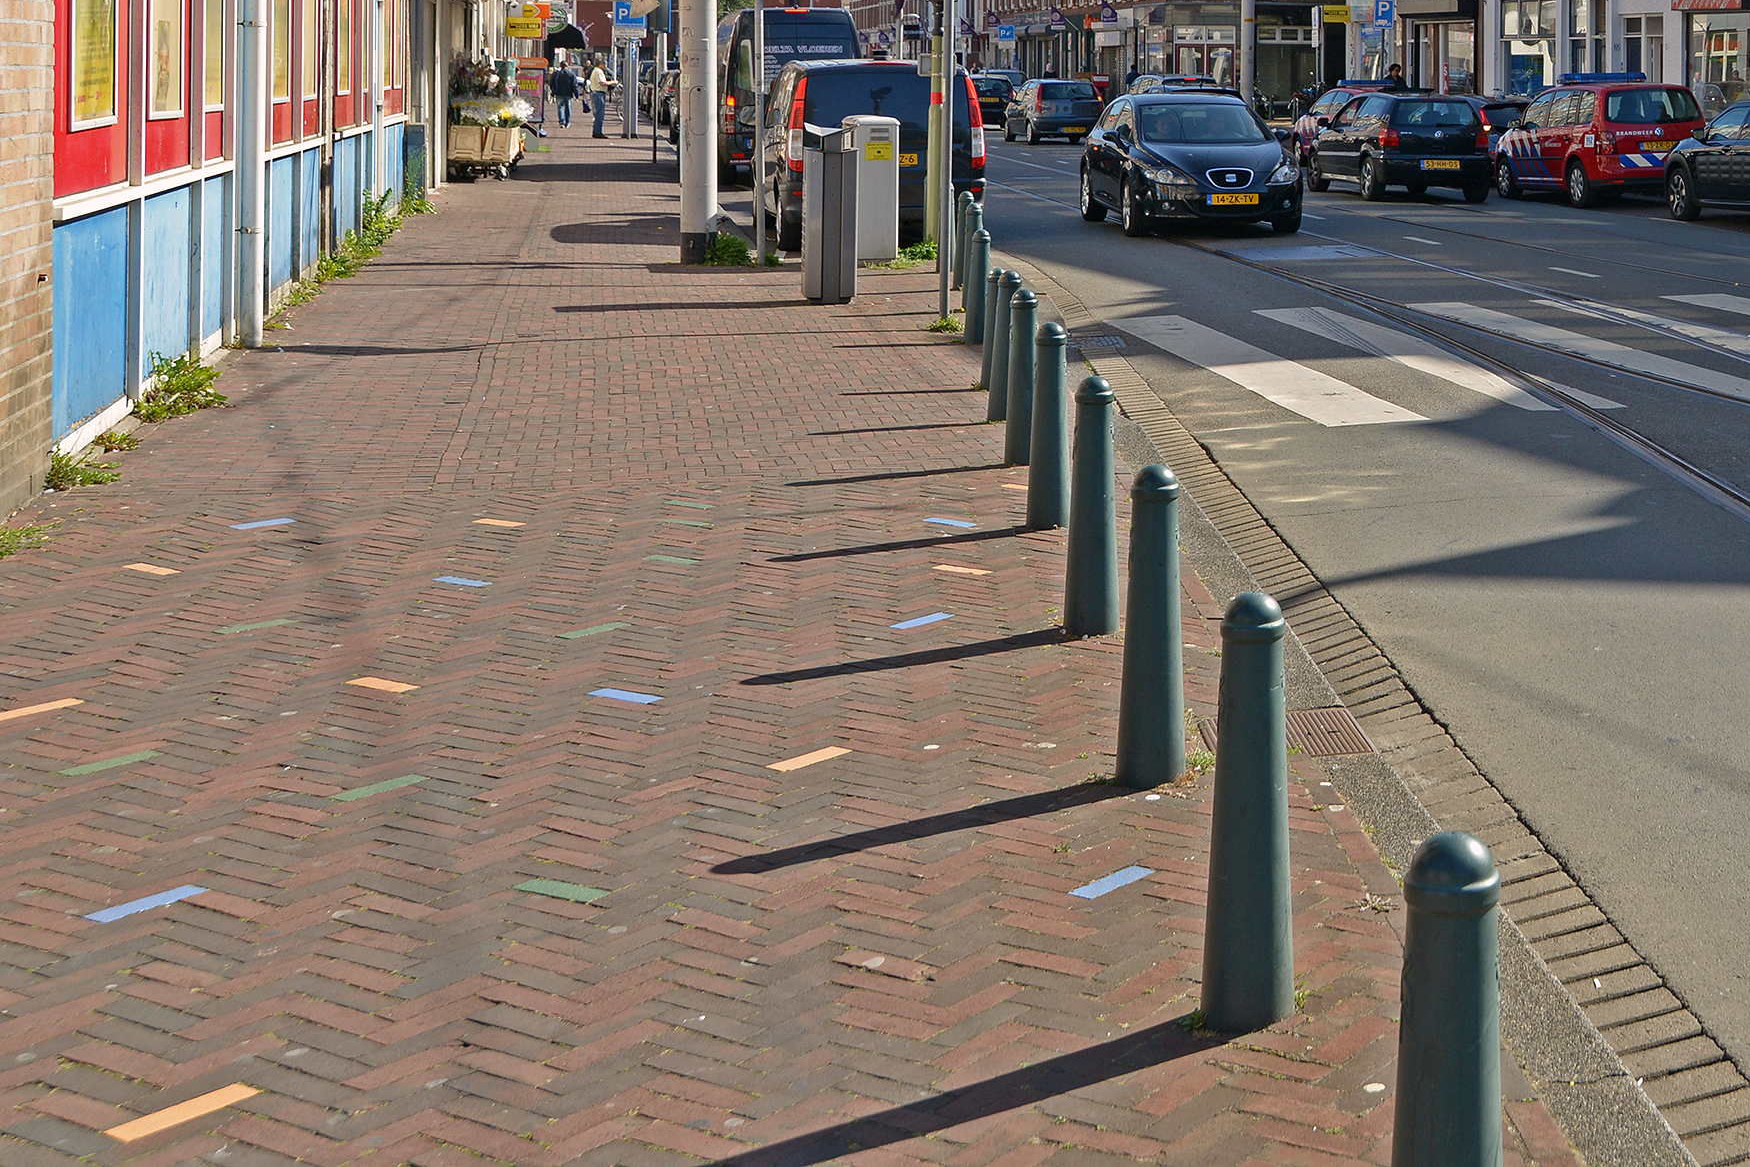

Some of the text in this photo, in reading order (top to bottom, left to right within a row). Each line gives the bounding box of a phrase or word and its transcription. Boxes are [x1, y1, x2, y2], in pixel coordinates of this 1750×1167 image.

[618, 7, 629, 20] P
[1378, 1, 1390, 17] P
[796, 44, 844, 54] VLOEREN
[1425, 160, 1459, 168] 53-HH-DS
[1216, 195, 1254, 204] 14-ZK-TV
